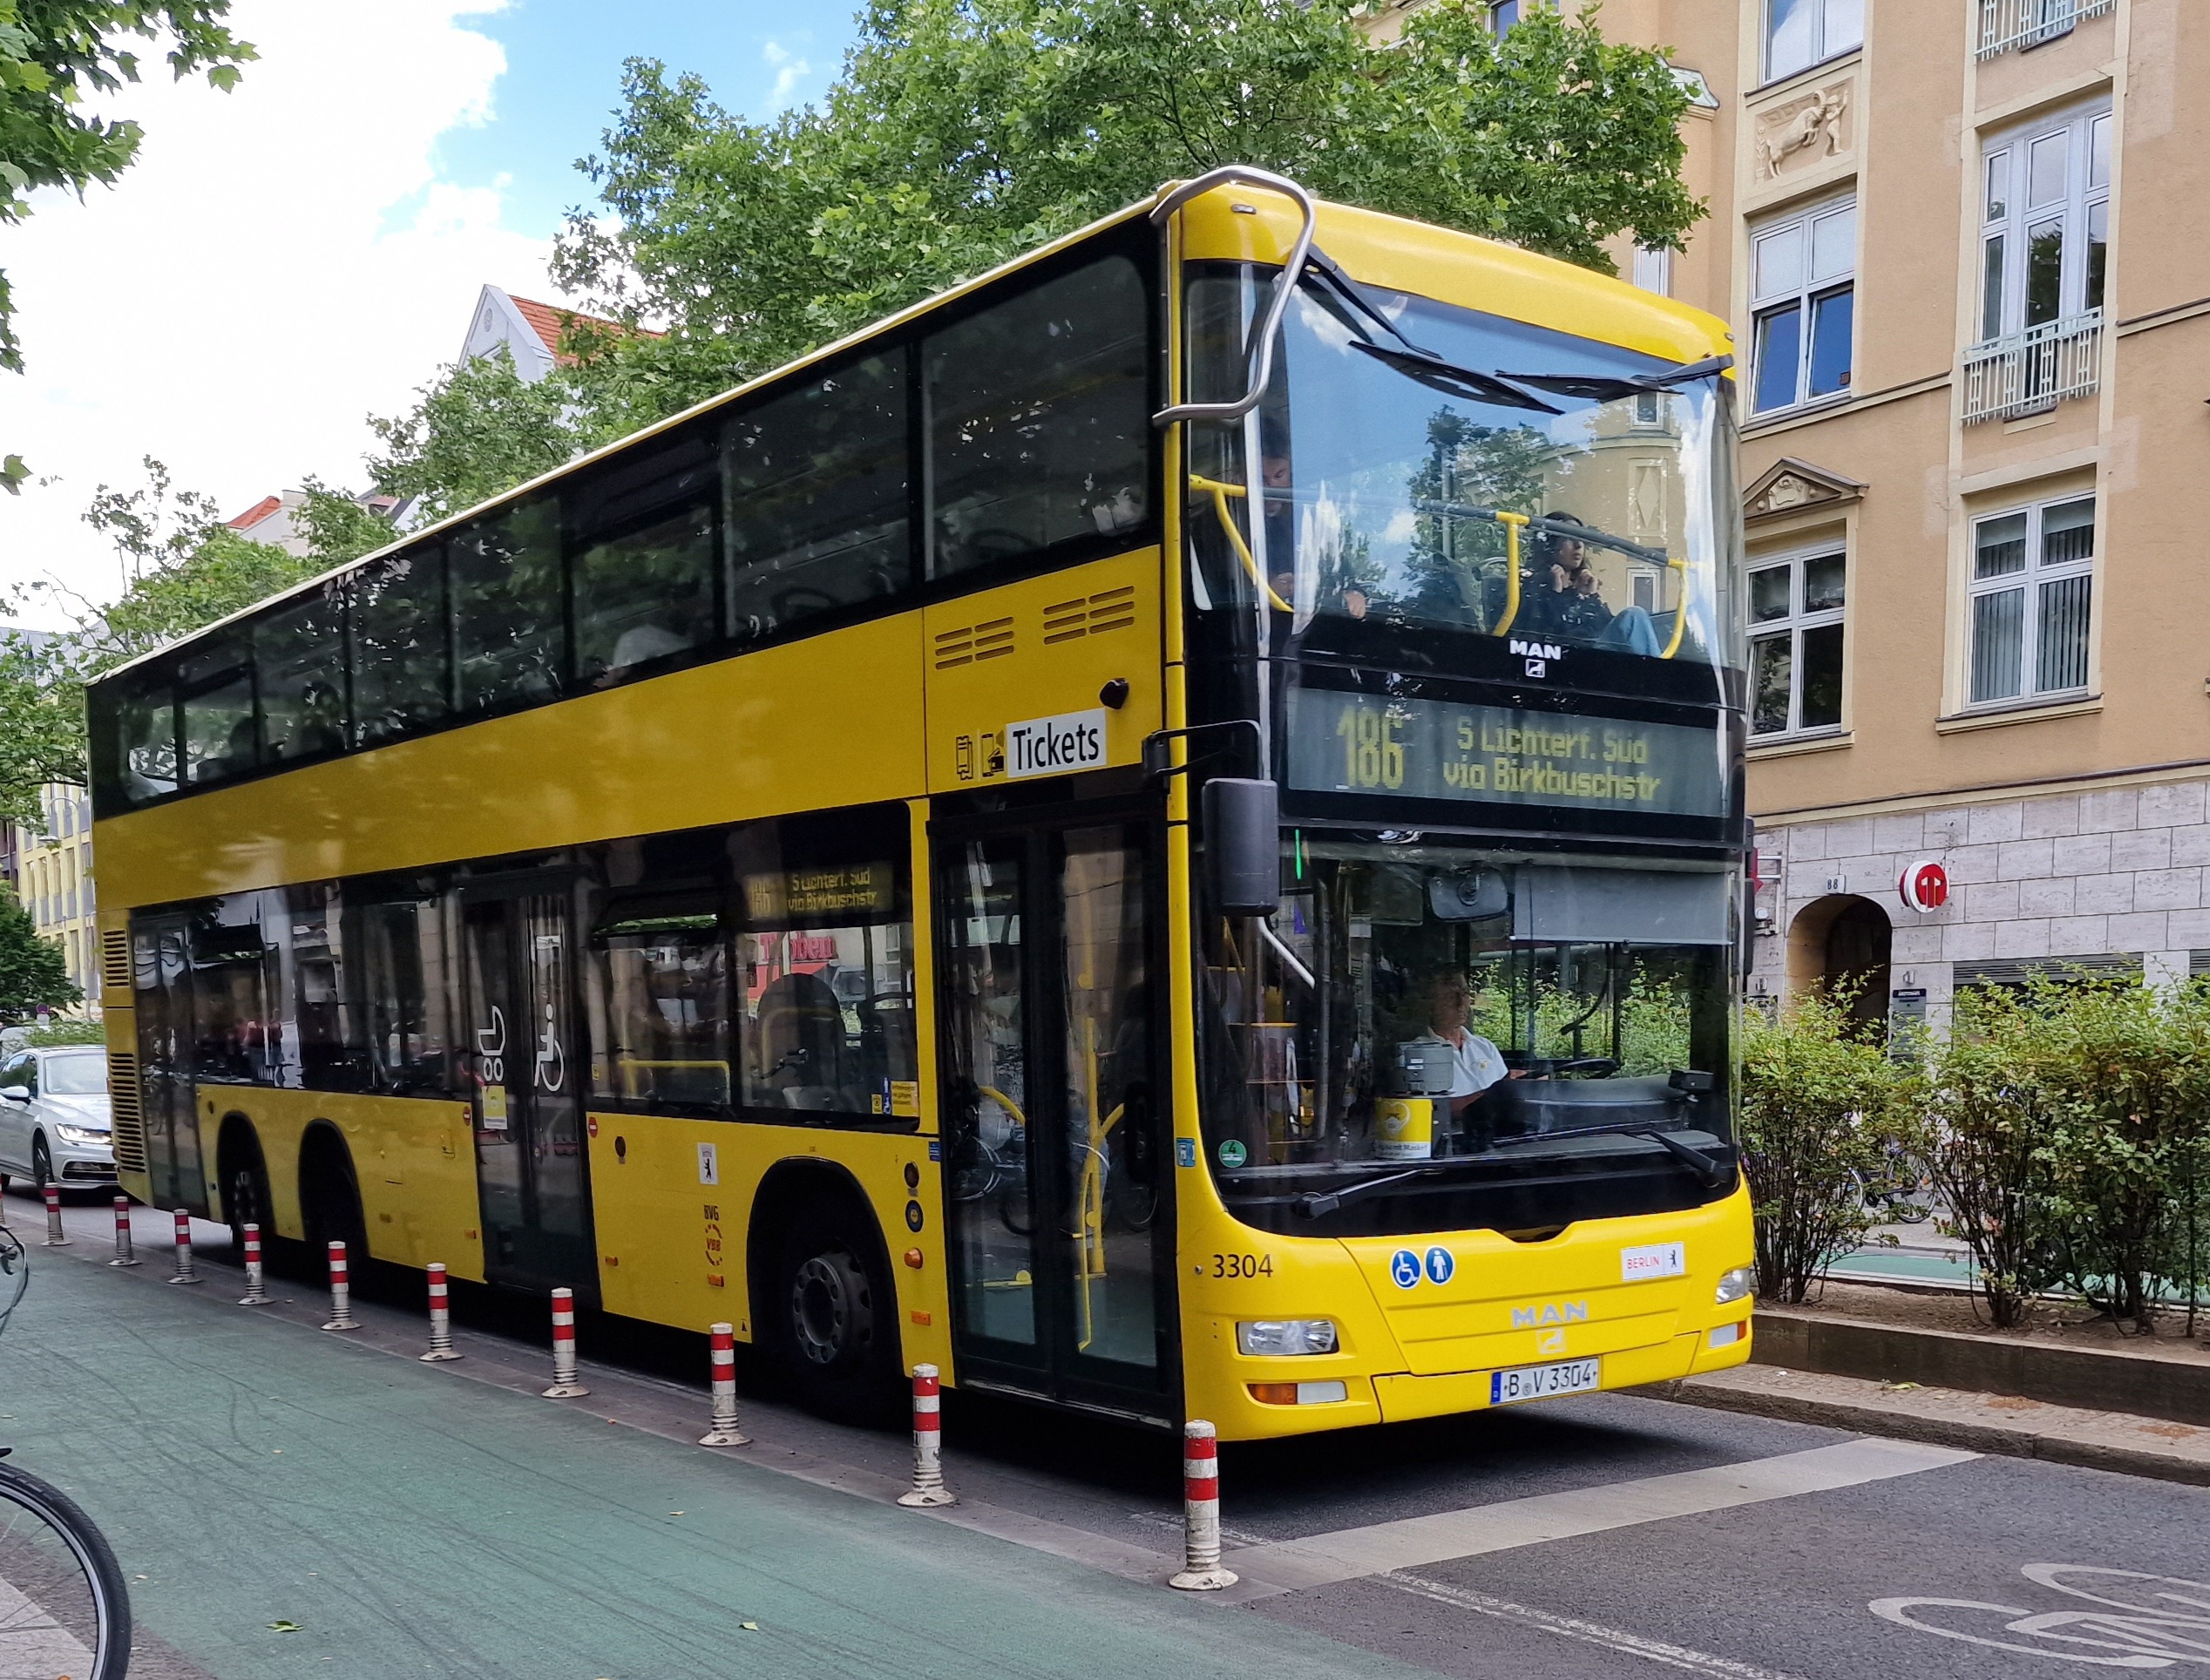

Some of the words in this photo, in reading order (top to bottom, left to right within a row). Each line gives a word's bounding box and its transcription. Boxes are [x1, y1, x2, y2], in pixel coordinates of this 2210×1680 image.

[1509, 640, 1562, 660] MAN
[1013, 722, 1099, 770] Tickets
[1457, 715, 1474, 750] S
[1337, 706, 1404, 789] 186
[1443, 755, 1487, 791] via
[1494, 756, 1661, 801] Birkbuschstr
[1827, 878, 1839, 890] 88
[704, 1204, 720, 1222] BVG
[1212, 1253, 1274, 1279] 3304
[1626, 1255, 1660, 1270] BERLIN
[1511, 1300, 1588, 1329] MAN
[1508, 1373, 1520, 1397] B
[1533, 1369, 1545, 1393] V
[1549, 1362, 1591, 1391] 3304
